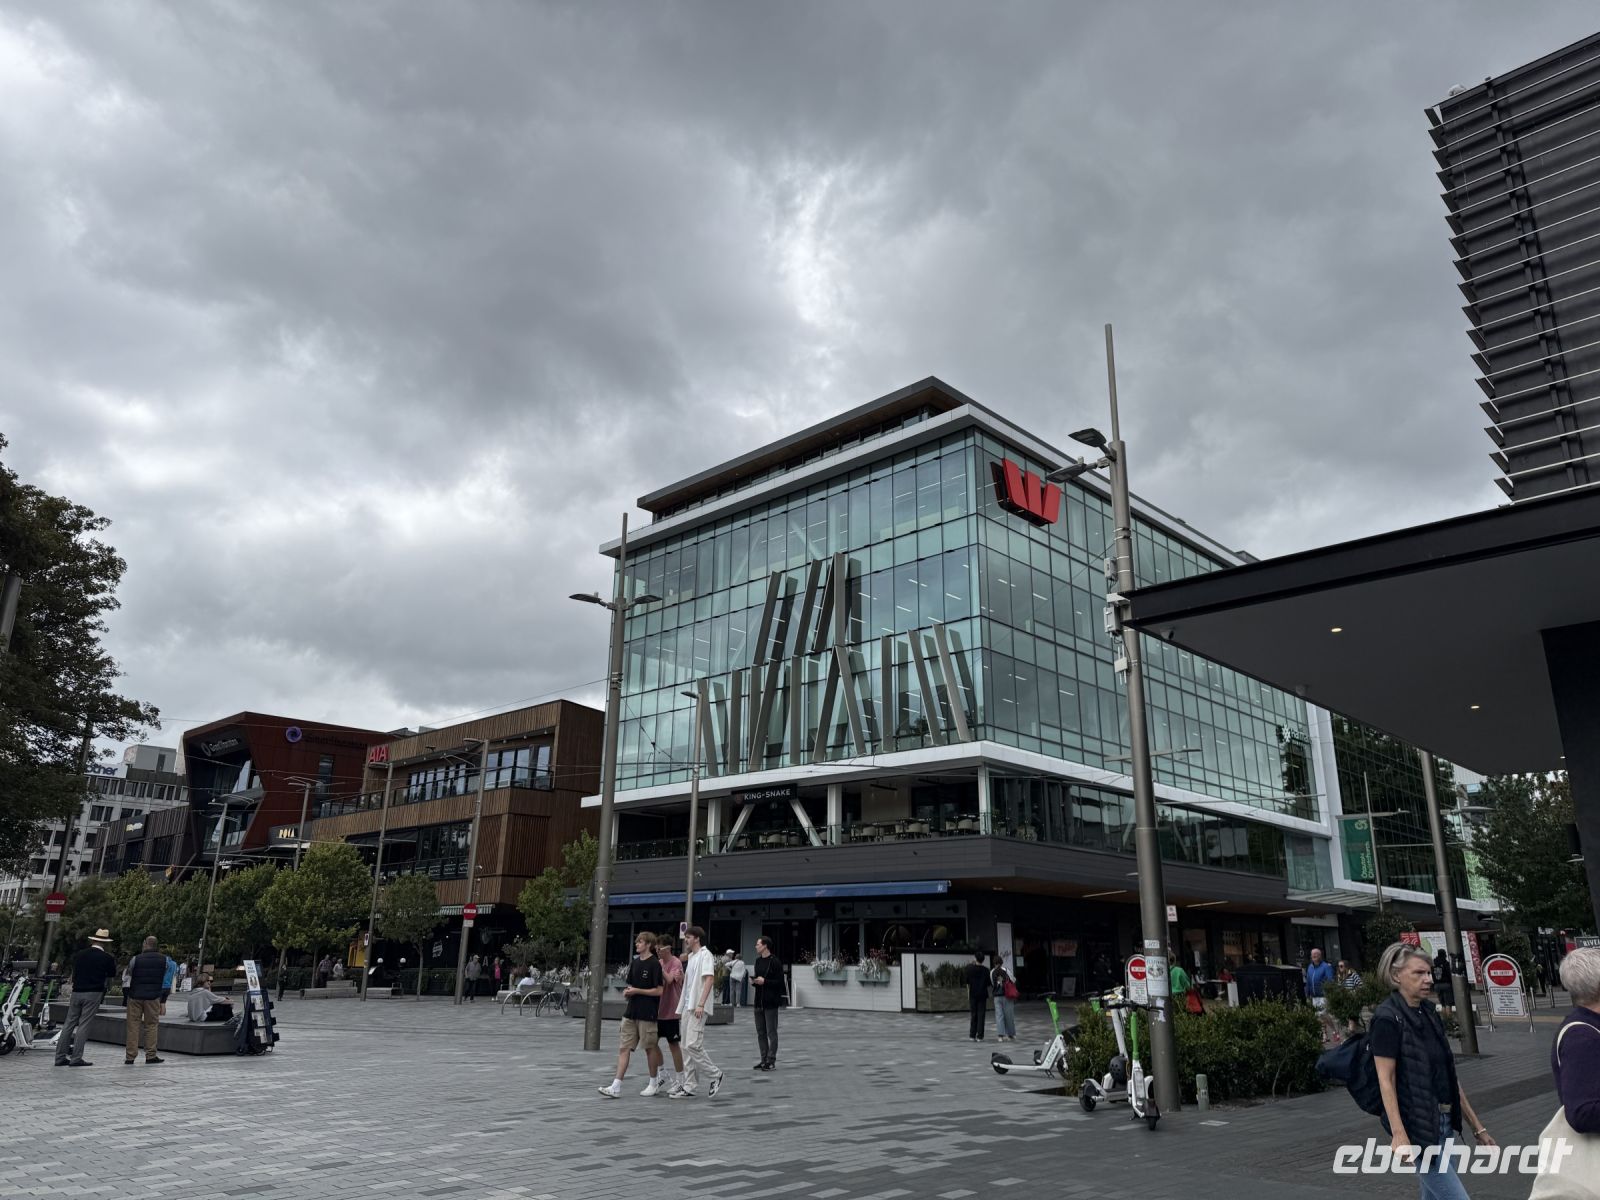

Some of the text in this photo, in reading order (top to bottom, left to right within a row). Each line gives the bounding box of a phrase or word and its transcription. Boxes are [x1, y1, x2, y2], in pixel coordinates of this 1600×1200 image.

[368, 745, 390, 762] AIA
[86, 764, 118, 776] other
[744, 789, 791, 801] KING-SNAKE
